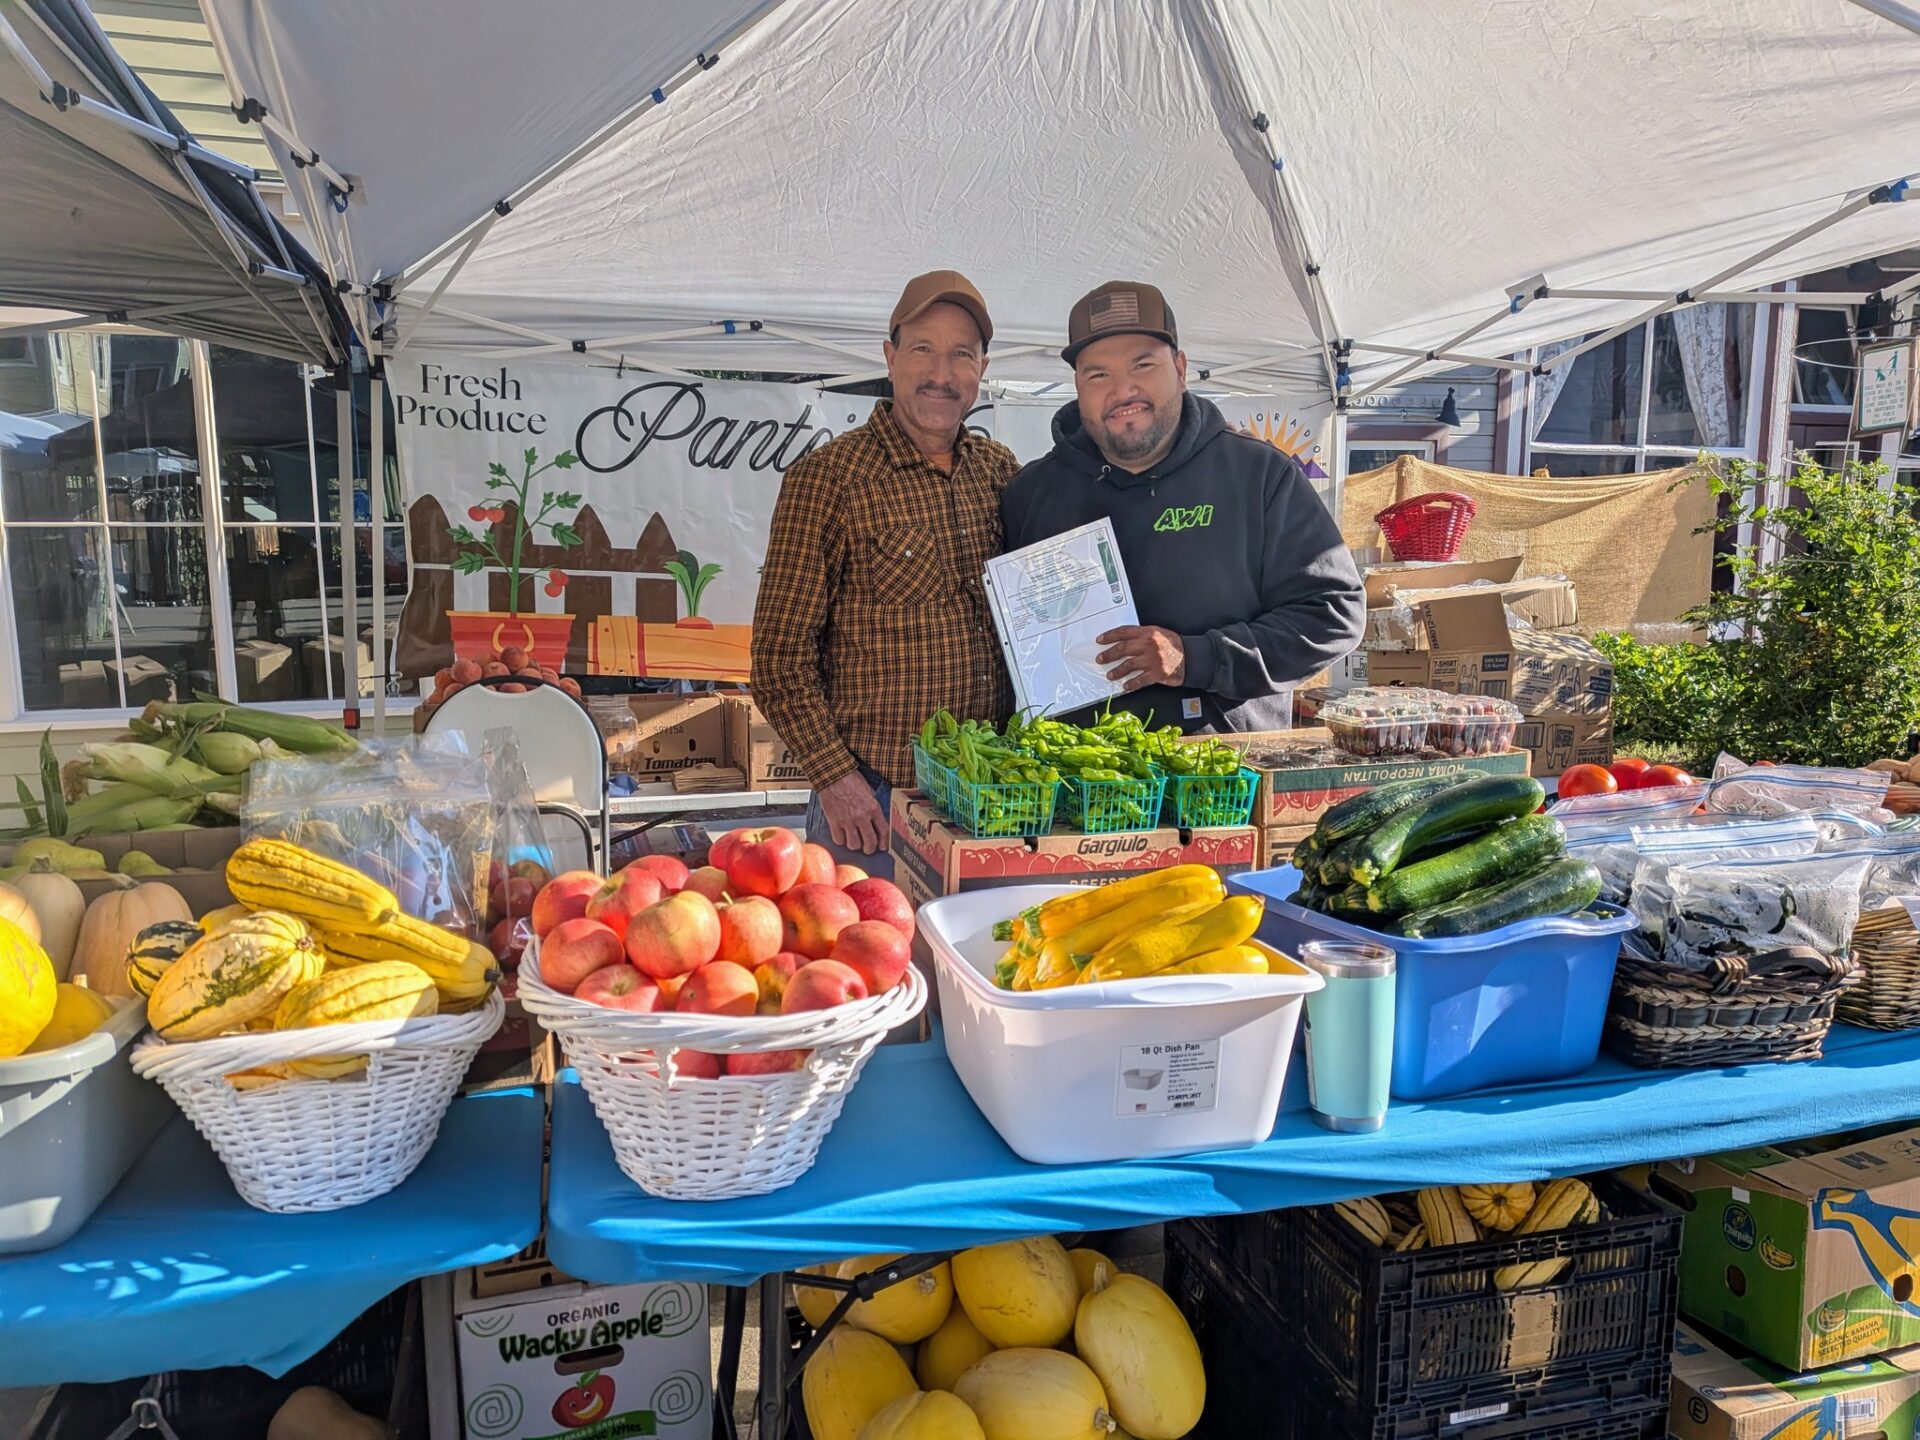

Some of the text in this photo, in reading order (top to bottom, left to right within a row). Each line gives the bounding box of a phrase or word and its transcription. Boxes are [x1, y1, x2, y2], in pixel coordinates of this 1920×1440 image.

[420, 363, 522, 401] Fresh
[396, 394, 548, 435] Produce
[575, 381, 858, 473] Pant
[1433, 660, 1458, 668] T-SHIRT
[1343, 763, 1466, 783] ROMA NEOPOLITAN
[1077, 834, 1148, 858] Gargiulo
[1140, 1043, 1200, 1055] 18 Qt Dish Pan
[547, 1302, 621, 1327] ORGANIC
[499, 1327, 588, 1363] Wacky
[590, 1311, 664, 1347] Apple
[1817, 1327, 1881, 1357] SELECTED QUALITY
[1818, 1320, 1879, 1349] ORGANIC BANANA
